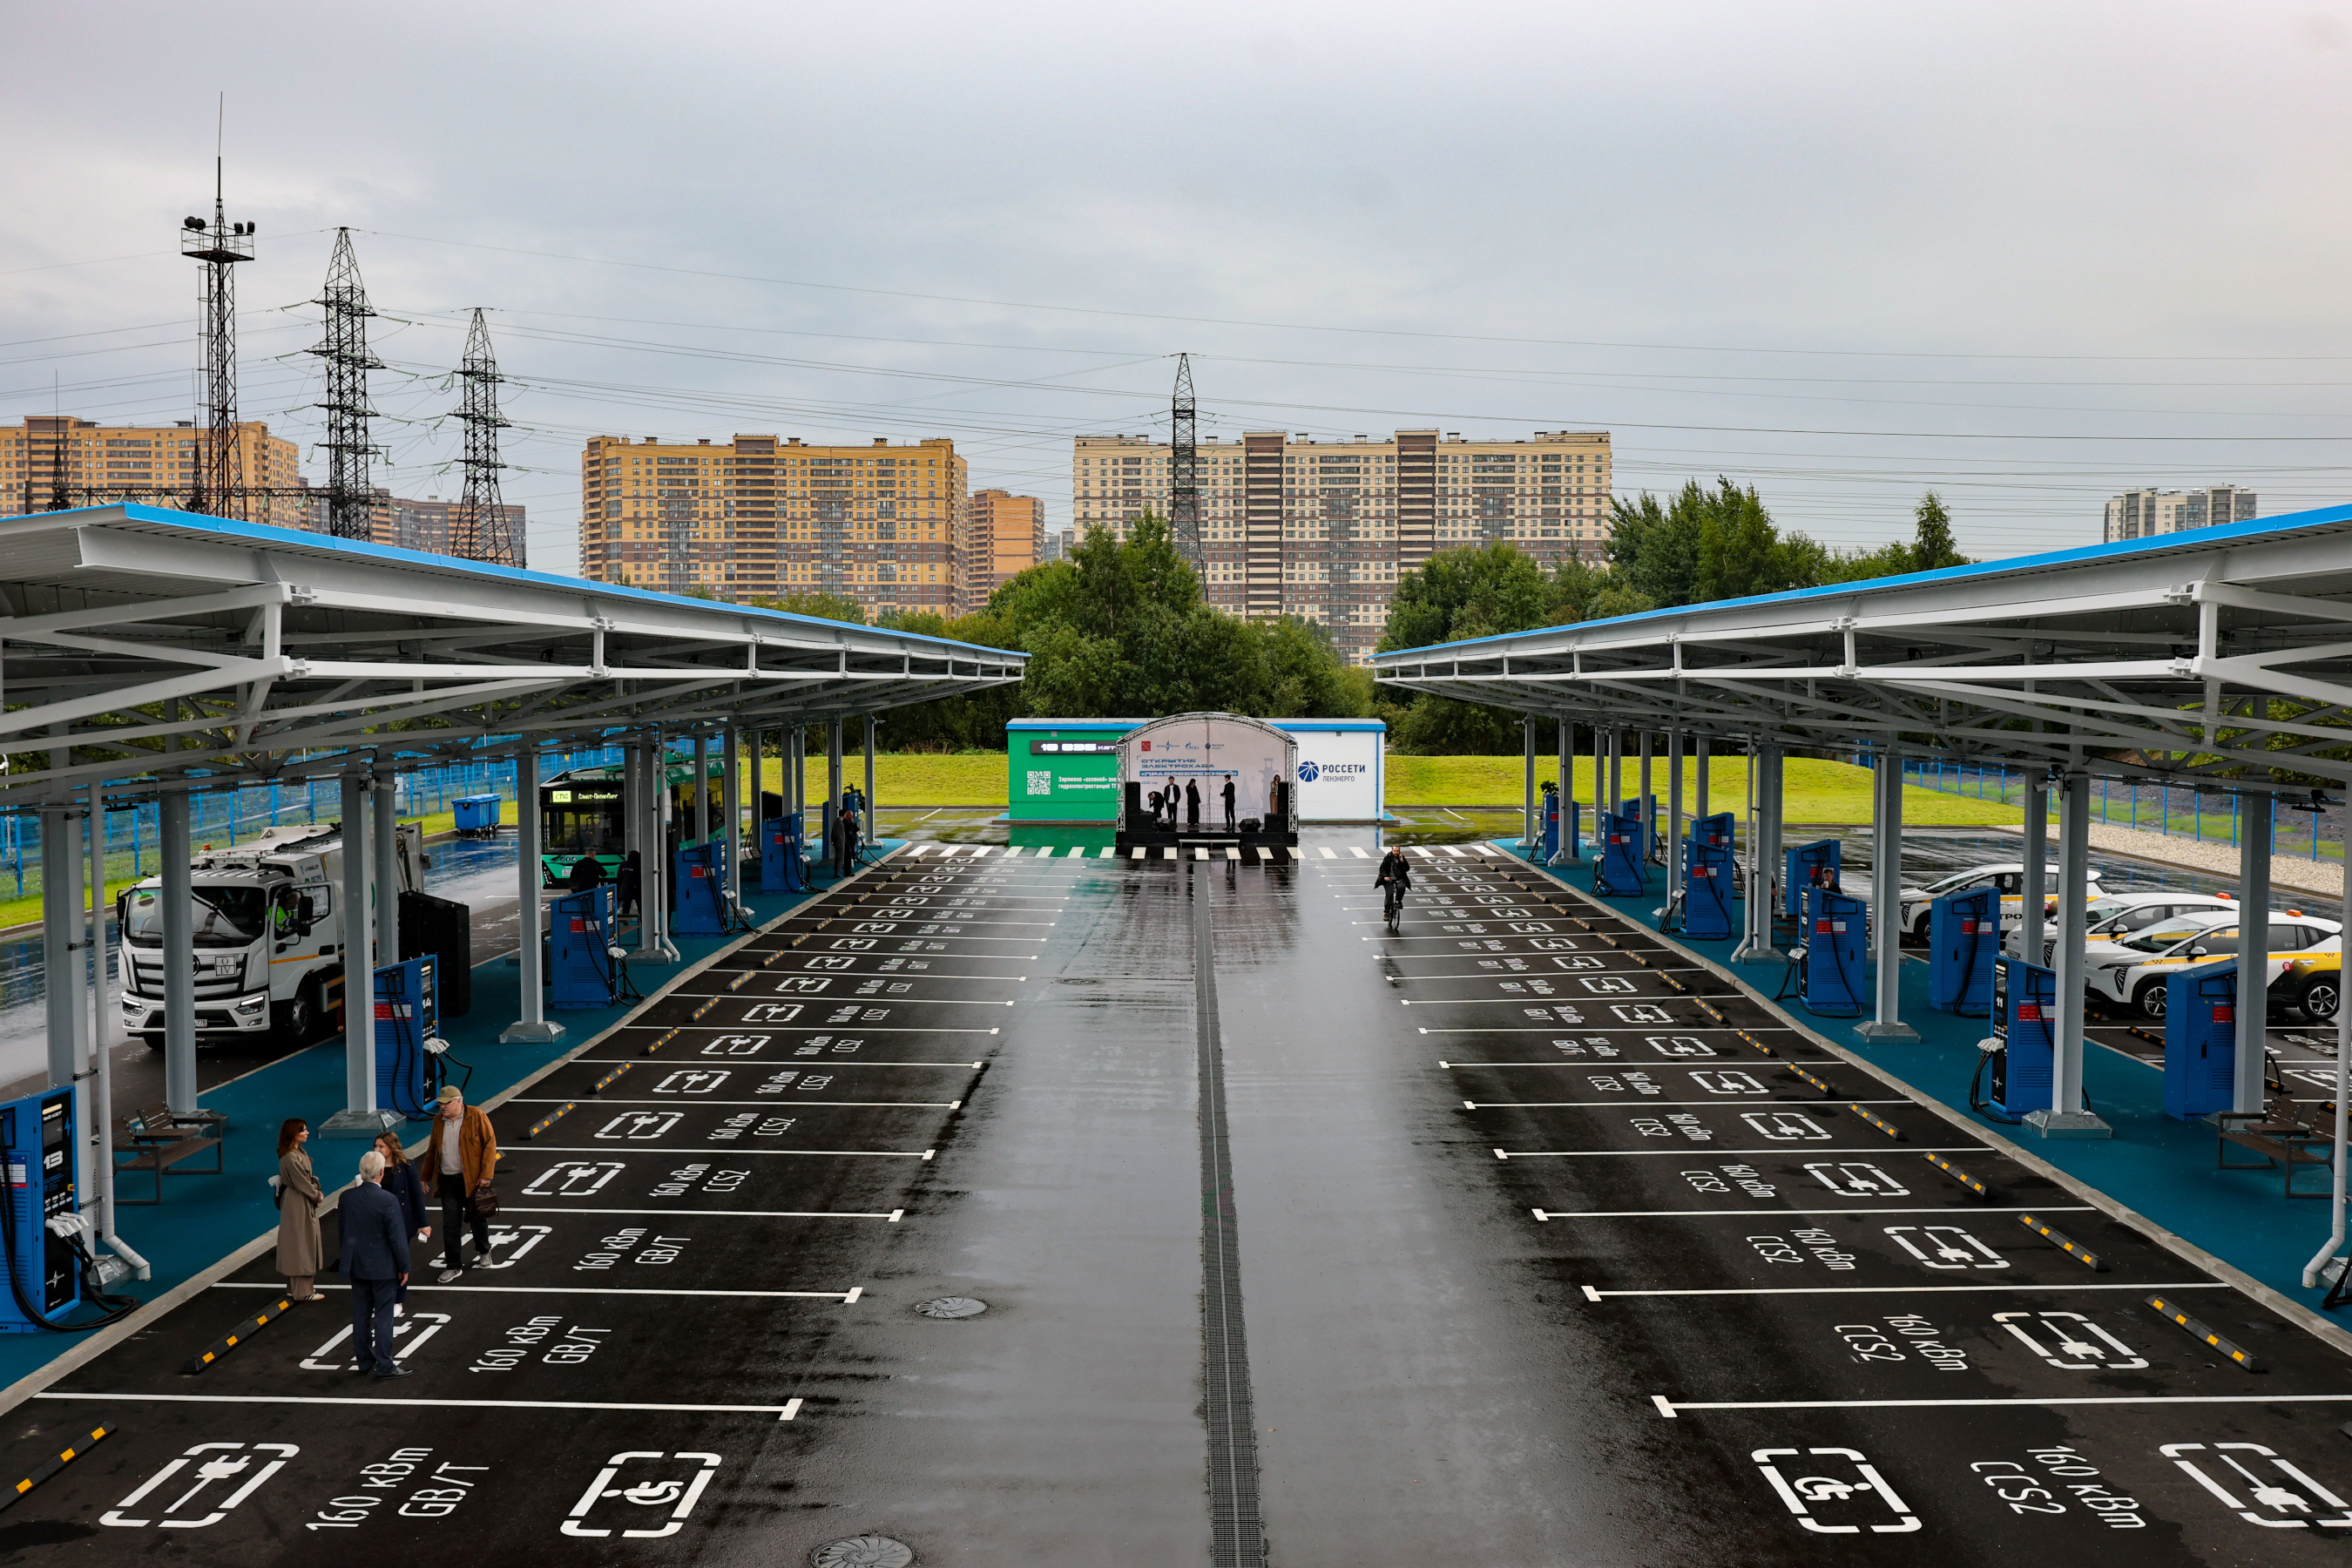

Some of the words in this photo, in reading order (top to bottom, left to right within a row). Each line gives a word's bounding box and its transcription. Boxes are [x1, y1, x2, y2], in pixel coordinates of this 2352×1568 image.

[422, 997, 432, 1009] 14
[1996, 997, 2003, 1008] 11
[831, 1039, 864, 1053] CCS2
[796, 1074, 834, 1091] CCS2
[1586, 1075, 1625, 1092] CCS2
[1619, 1071, 1652, 1082] 160
[754, 1084, 787, 1094] 160
[753, 1118, 797, 1137] CCS2
[1629, 1118, 1673, 1137] CCS2
[1665, 1112, 1701, 1125] 160
[706, 1128, 744, 1140] 160
[44, 1150, 64, 1170] 13
[1718, 1164, 1761, 1178] 160
[648, 1182, 690, 1197] 160
[701, 1170, 752, 1193] CCS2
[1680, 1170, 1731, 1193] CCS2
[1789, 1227, 1837, 1245] 160
[634, 1235, 692, 1264] GB/T
[1746, 1235, 1805, 1264] CCS2
[572, 1252, 621, 1271] 160
[1882, 1314, 1941, 1335] 160
[542, 1325, 612, 1364] GB/T
[1834, 1324, 1907, 1362] CCS2
[468, 1348, 528, 1374] 160
[2025, 1445, 2101, 1477] 160
[397, 1461, 490, 1517] GB/T
[1970, 1460, 2068, 1516] CCS2
[305, 1495, 382, 1531] 160
